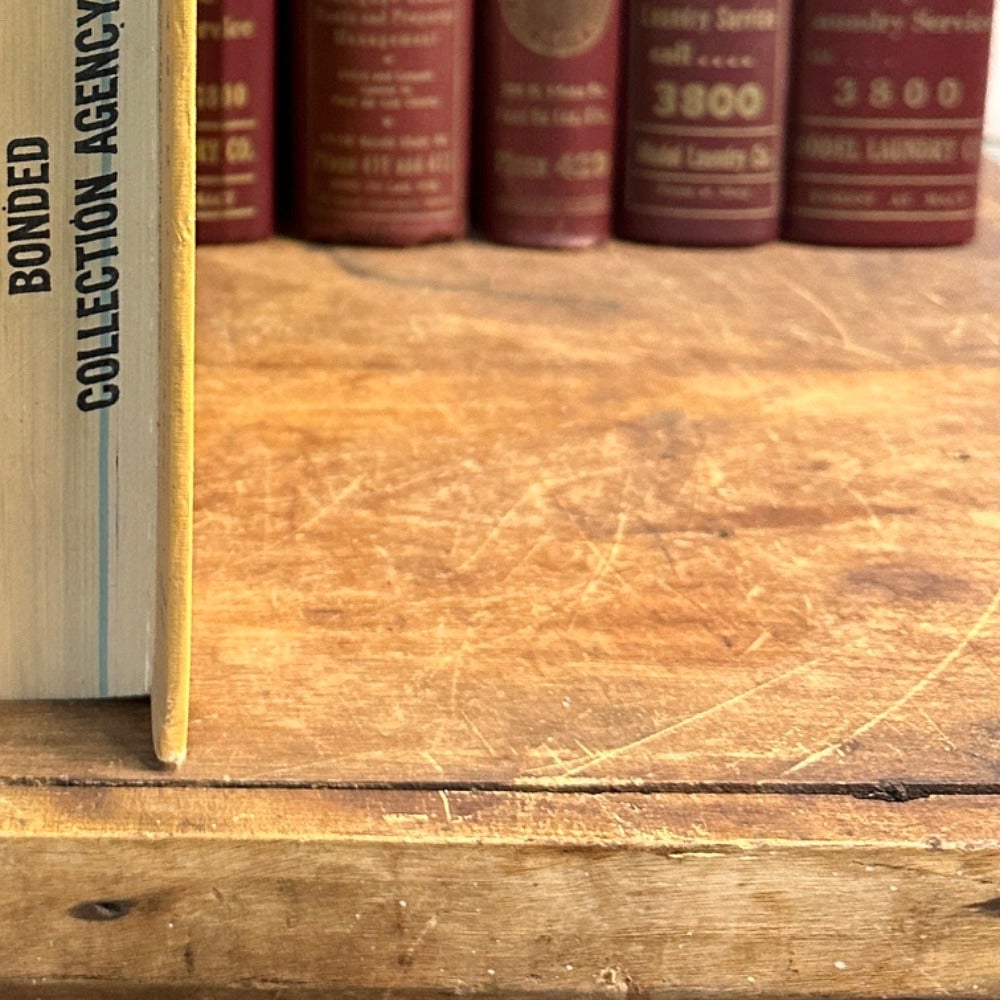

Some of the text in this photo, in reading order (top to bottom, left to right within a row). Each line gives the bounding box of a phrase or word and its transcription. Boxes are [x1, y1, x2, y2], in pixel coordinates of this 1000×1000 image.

[652, 81, 766, 120] 3800
[6, 136, 52, 296] BONDED
[74, 170, 120, 413] COLLECTION
